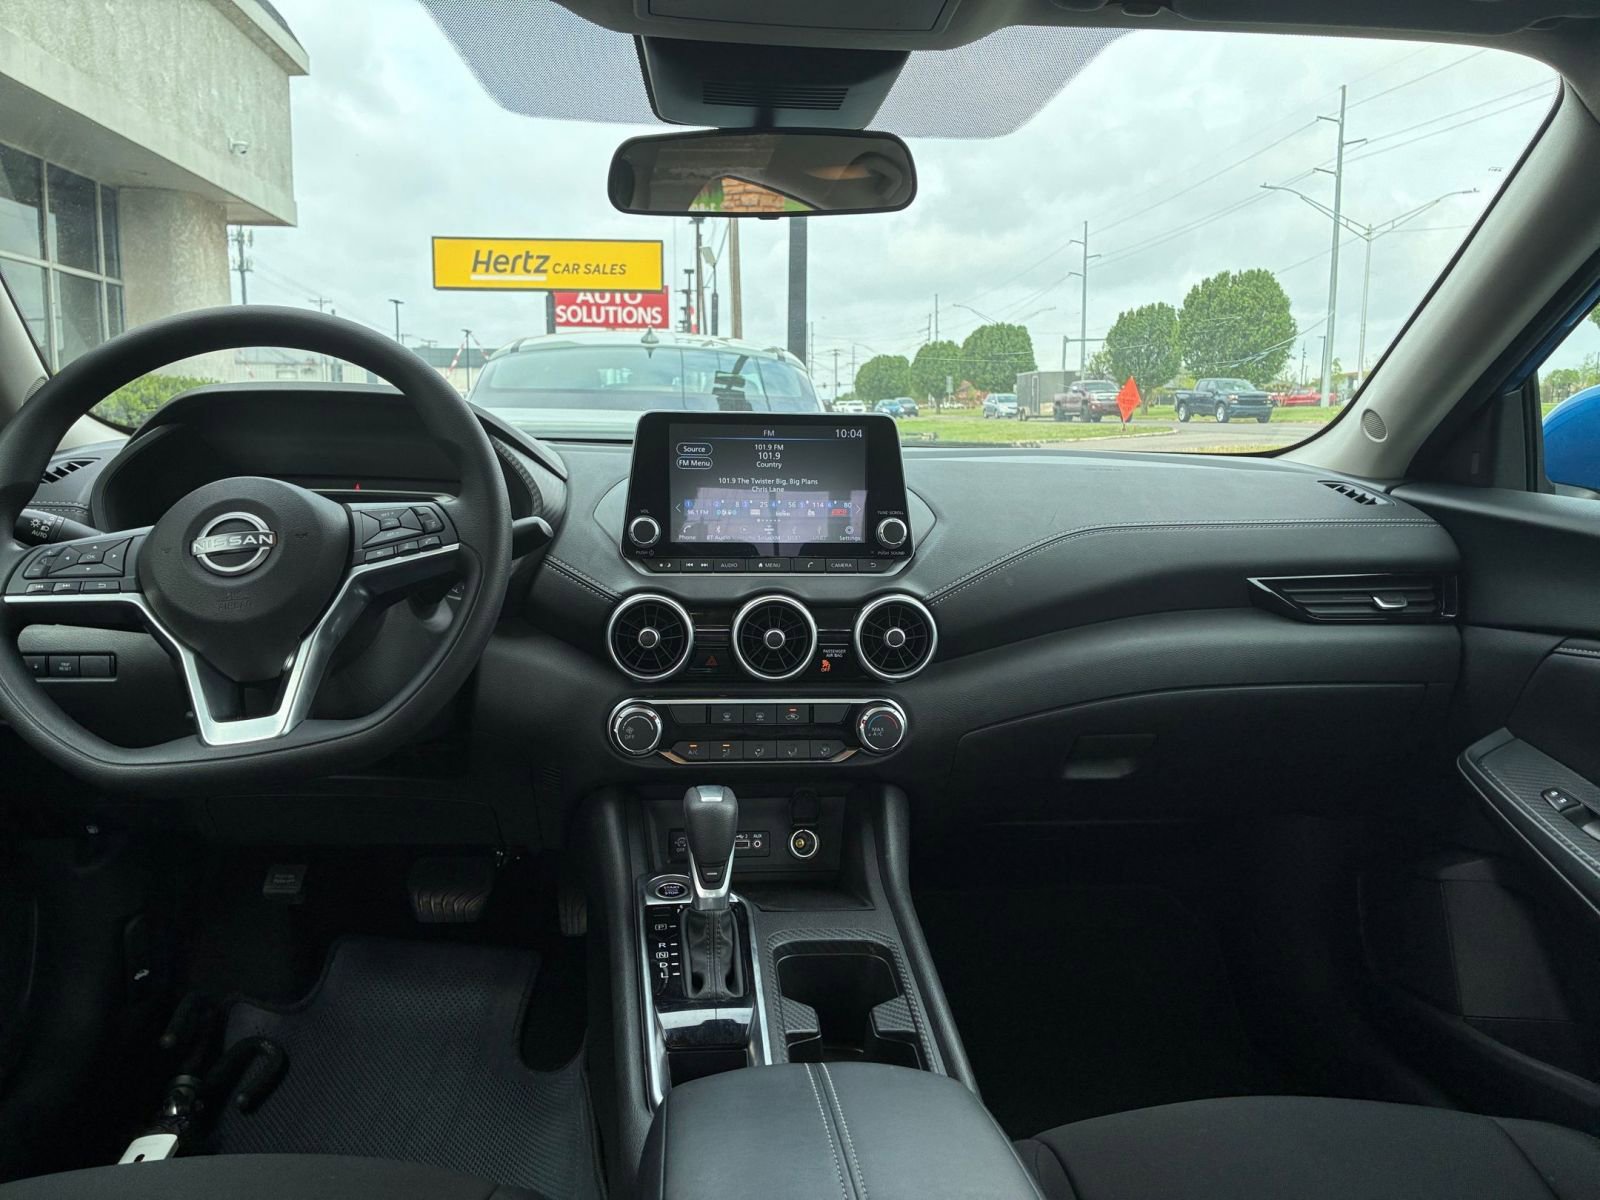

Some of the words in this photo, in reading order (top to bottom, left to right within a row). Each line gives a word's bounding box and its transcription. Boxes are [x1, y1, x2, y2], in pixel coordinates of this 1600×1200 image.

[471, 249, 550, 274] Hertz
[552, 262, 580, 275] CAR
[583, 263, 627, 276] SALES
[576, 291, 642, 304] AUTO
[555, 305, 662, 325] SOLUTIONS
[763, 429, 775, 437] FM
[835, 428, 863, 438] 10:04
[683, 445, 706, 453] Source
[758, 451, 781, 460] 101.9
[678, 459, 690, 467] FM
[690, 459, 711, 467] Menu
[756, 461, 783, 470] Country
[751, 477, 775, 485] Twister
[789, 478, 800, 487] Big
[801, 478, 819, 486] Plans
[768, 486, 785, 494] Lane
[31, 530, 48, 539] AUTO
[192, 534, 274, 553] NISSAN
